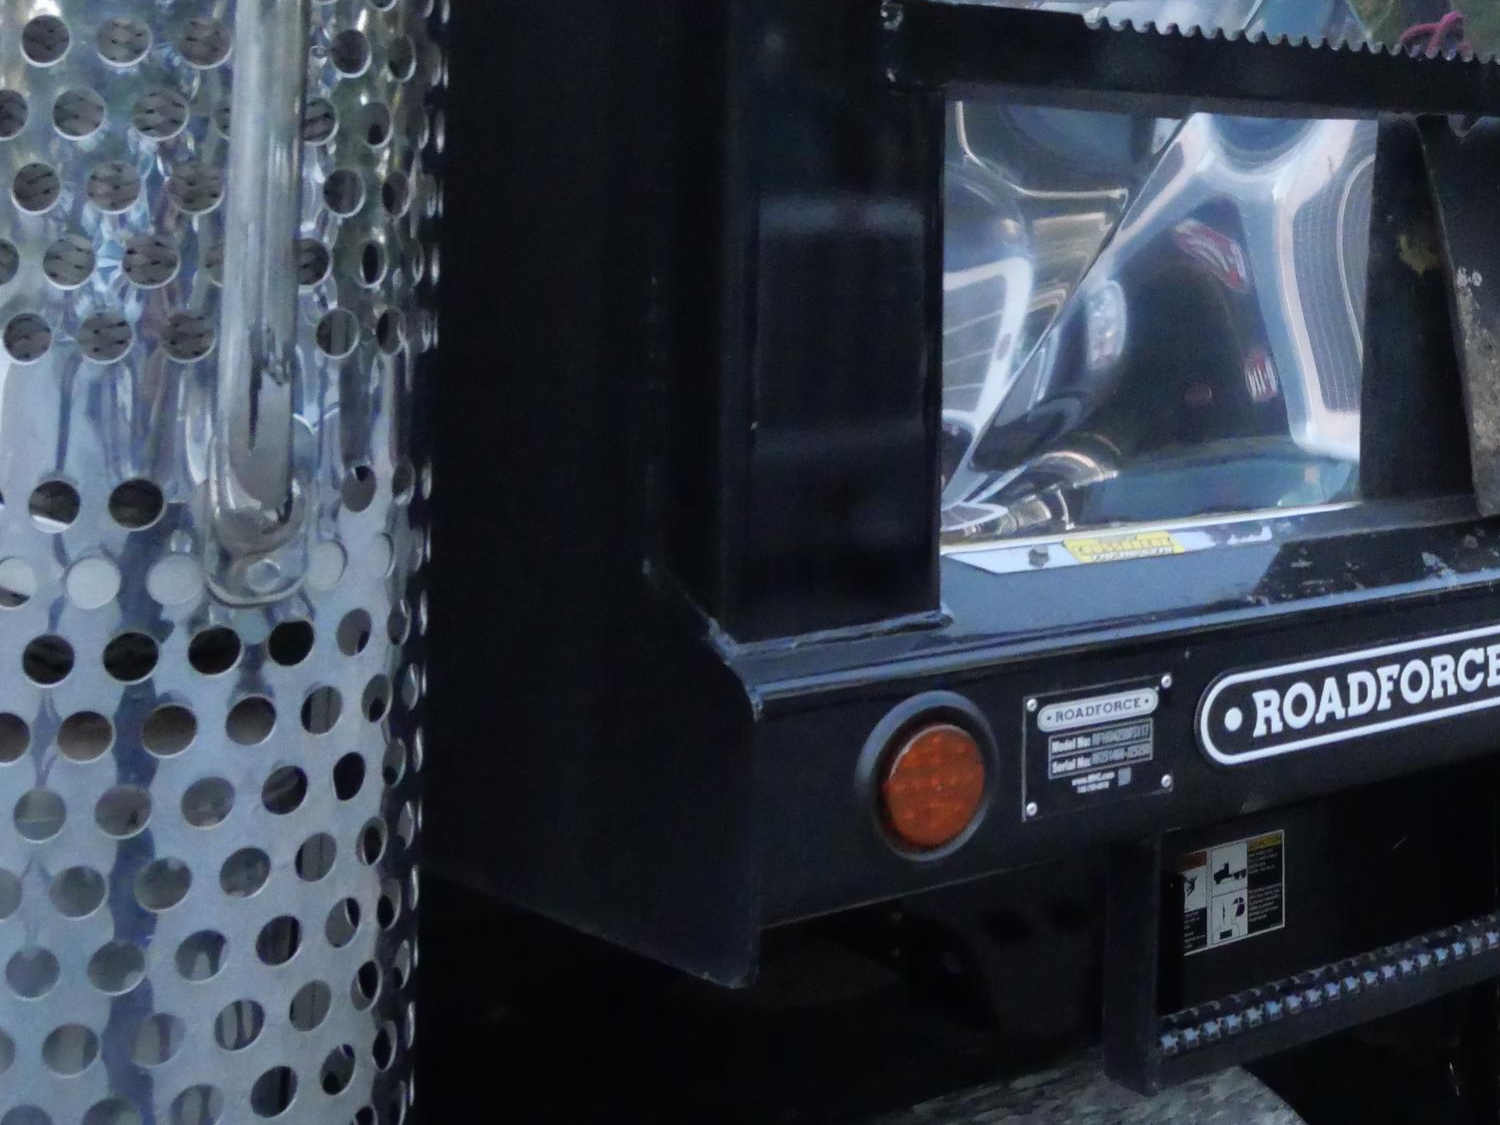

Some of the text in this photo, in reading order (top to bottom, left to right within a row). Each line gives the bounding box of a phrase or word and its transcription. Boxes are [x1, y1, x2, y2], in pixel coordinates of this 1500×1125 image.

[1055, 697, 1142, 723] ROADFORCE
[1051, 736, 1076, 754] Model
[1051, 757, 1076, 774] Serial
